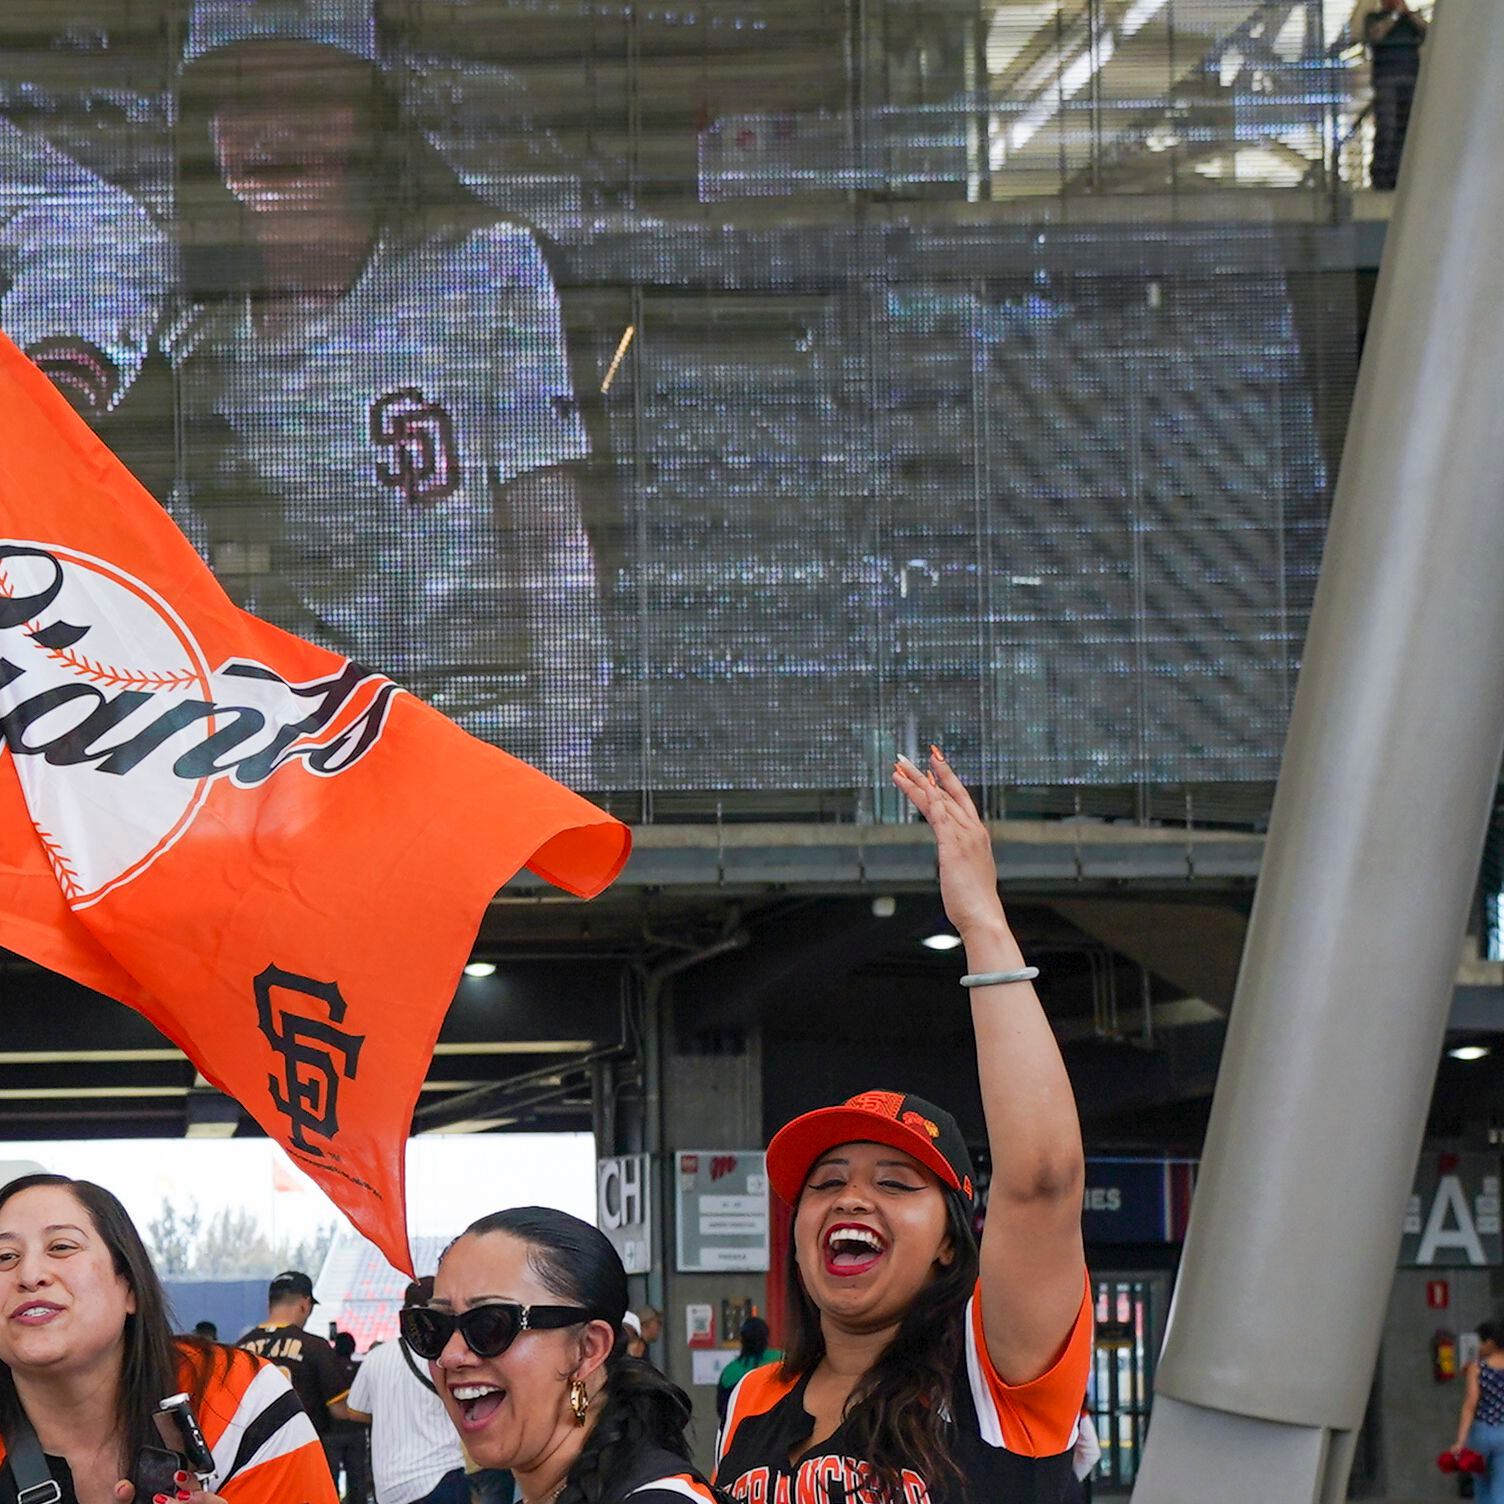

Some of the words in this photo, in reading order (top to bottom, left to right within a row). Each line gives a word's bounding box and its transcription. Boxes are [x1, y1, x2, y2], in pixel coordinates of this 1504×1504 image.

[253, 961, 366, 1157] SF
[599, 1157, 642, 1230] CH
[1416, 1175, 1487, 1266] A
